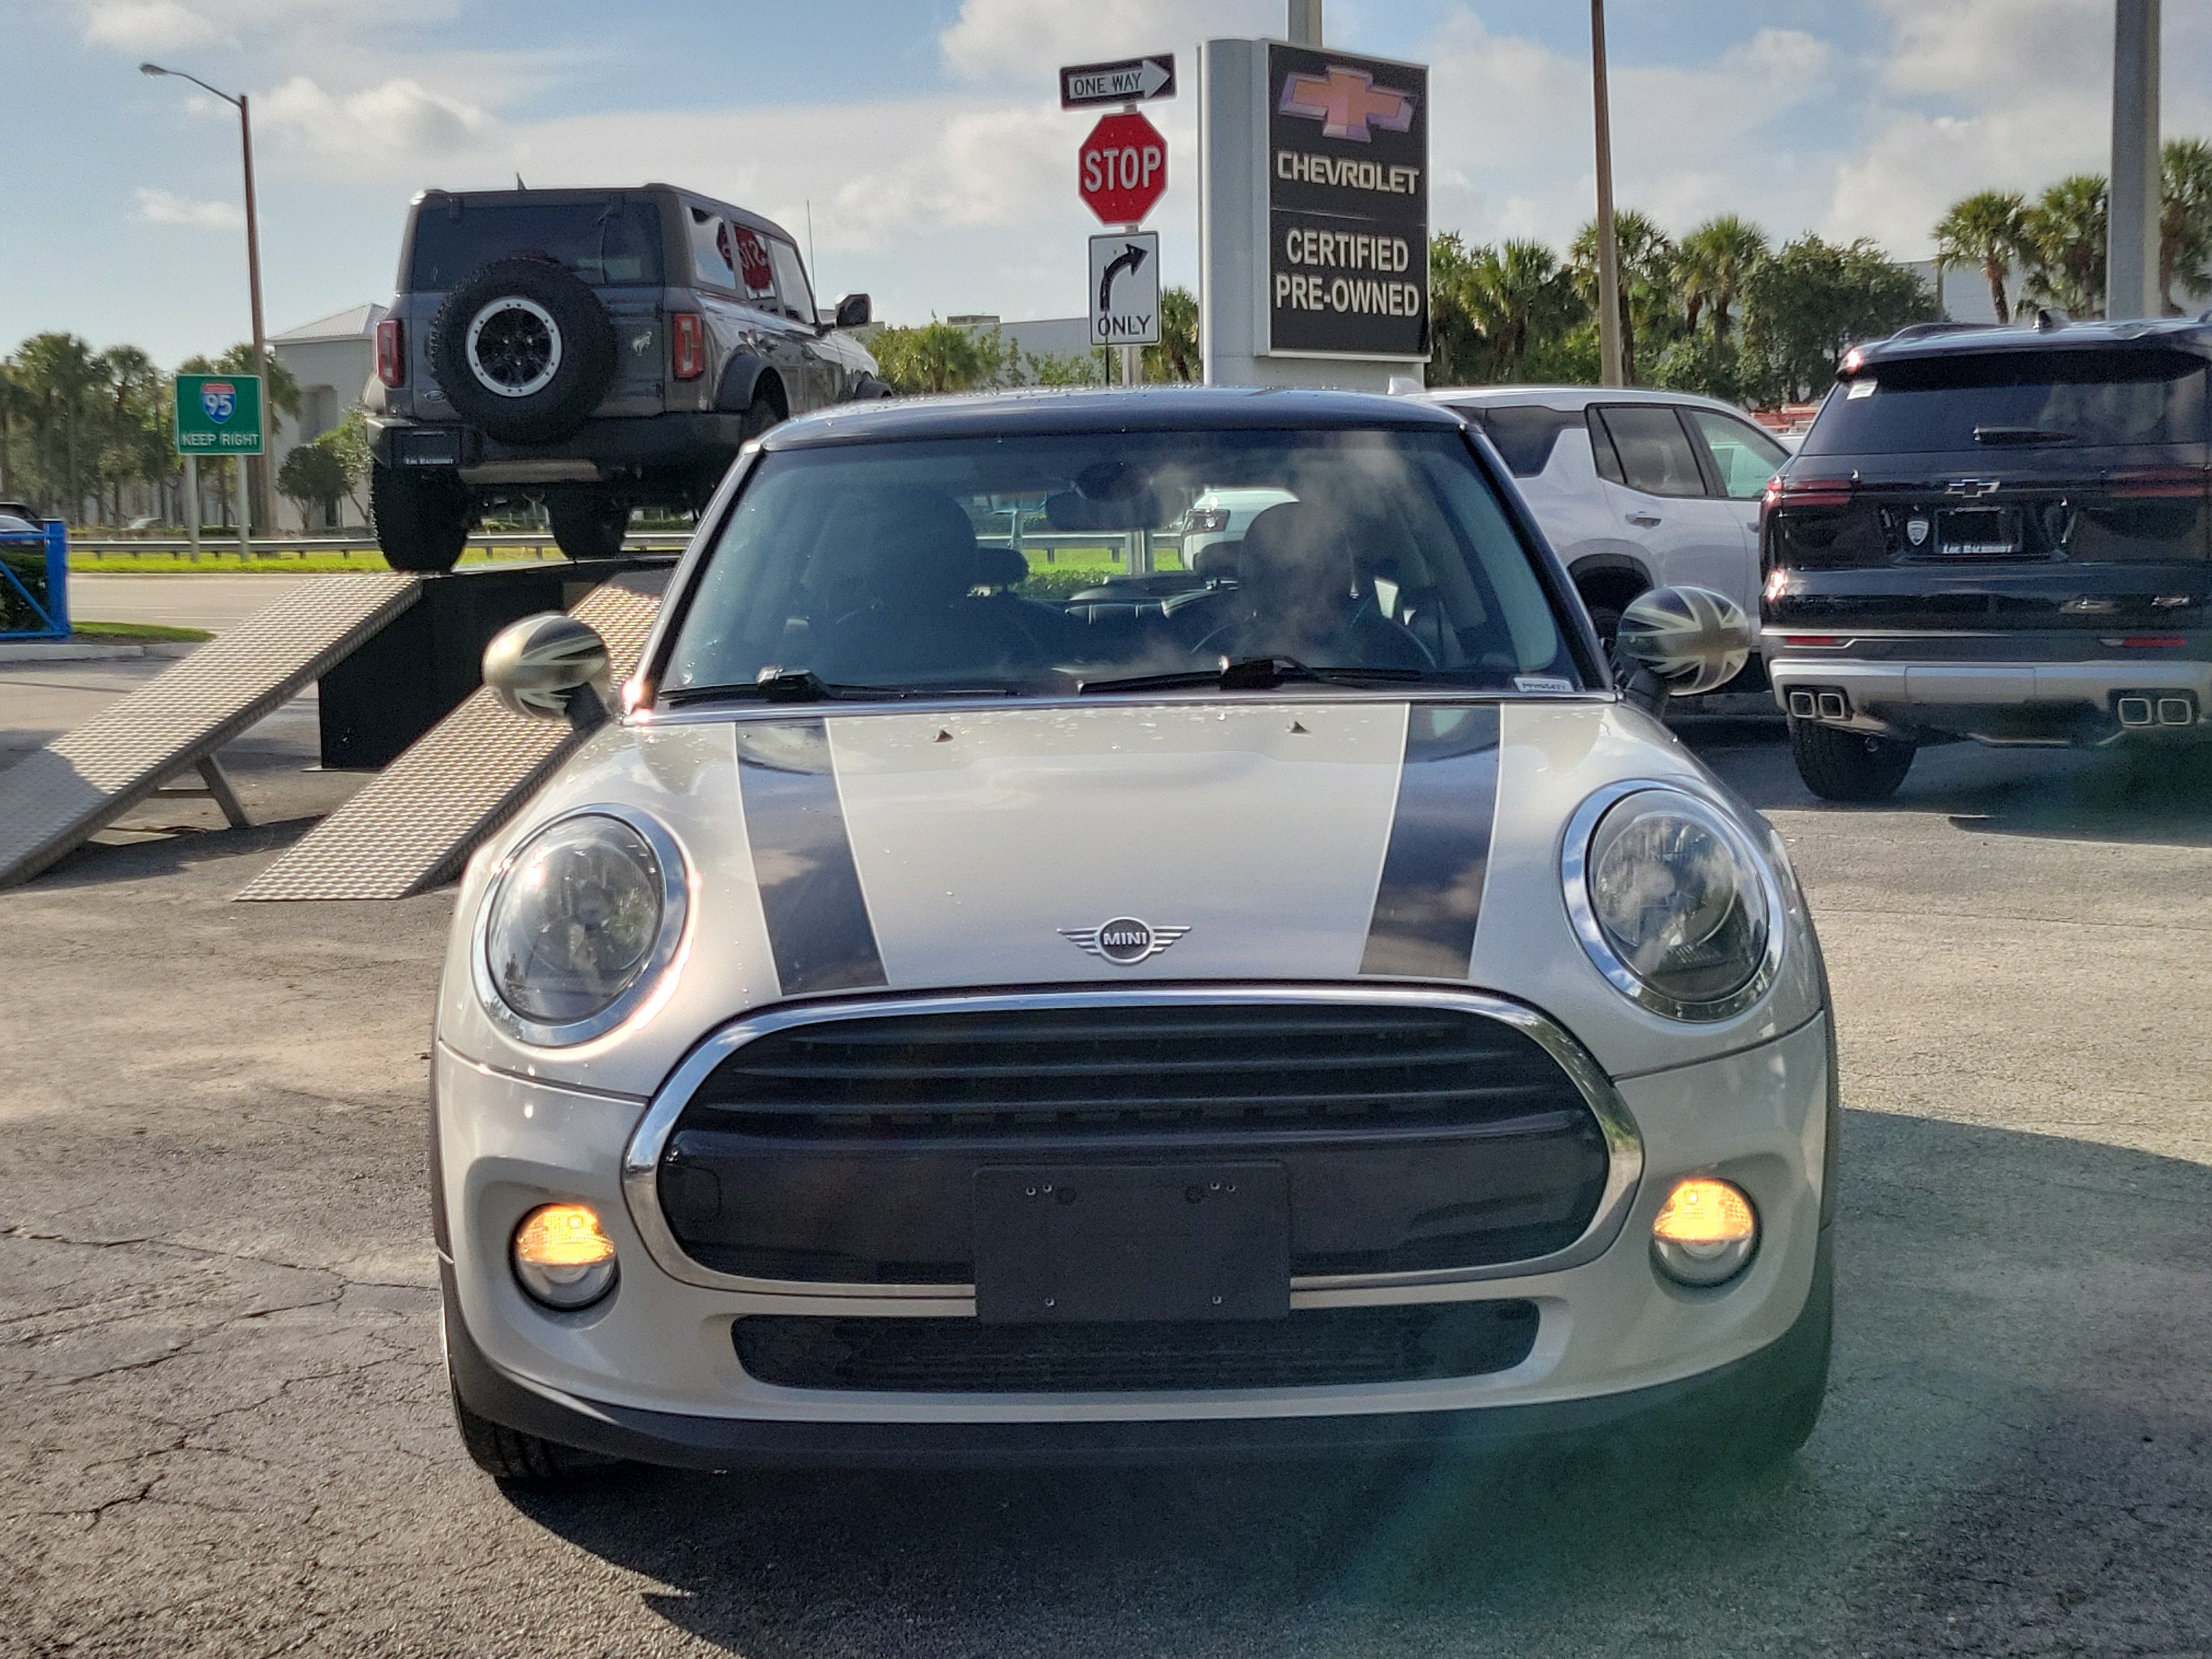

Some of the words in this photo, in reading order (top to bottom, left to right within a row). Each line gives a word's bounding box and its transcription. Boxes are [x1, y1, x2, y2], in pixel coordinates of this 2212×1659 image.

[1074, 77, 1107, 95] ONE
[1112, 72, 1141, 92] WAY
[1085, 148, 1161, 192] STOP
[1277, 151, 1420, 195] CHEVROLET
[1286, 229, 1409, 272] CERTIFIED
[1276, 273, 1420, 317] PRE-OWNED
[1098, 314, 1151, 336] ONLY
[204, 394, 233, 416] 95
[182, 433, 217, 446] KEEP
[222, 433, 259, 446] RIGHT
[1103, 932, 1147, 945] MINI
